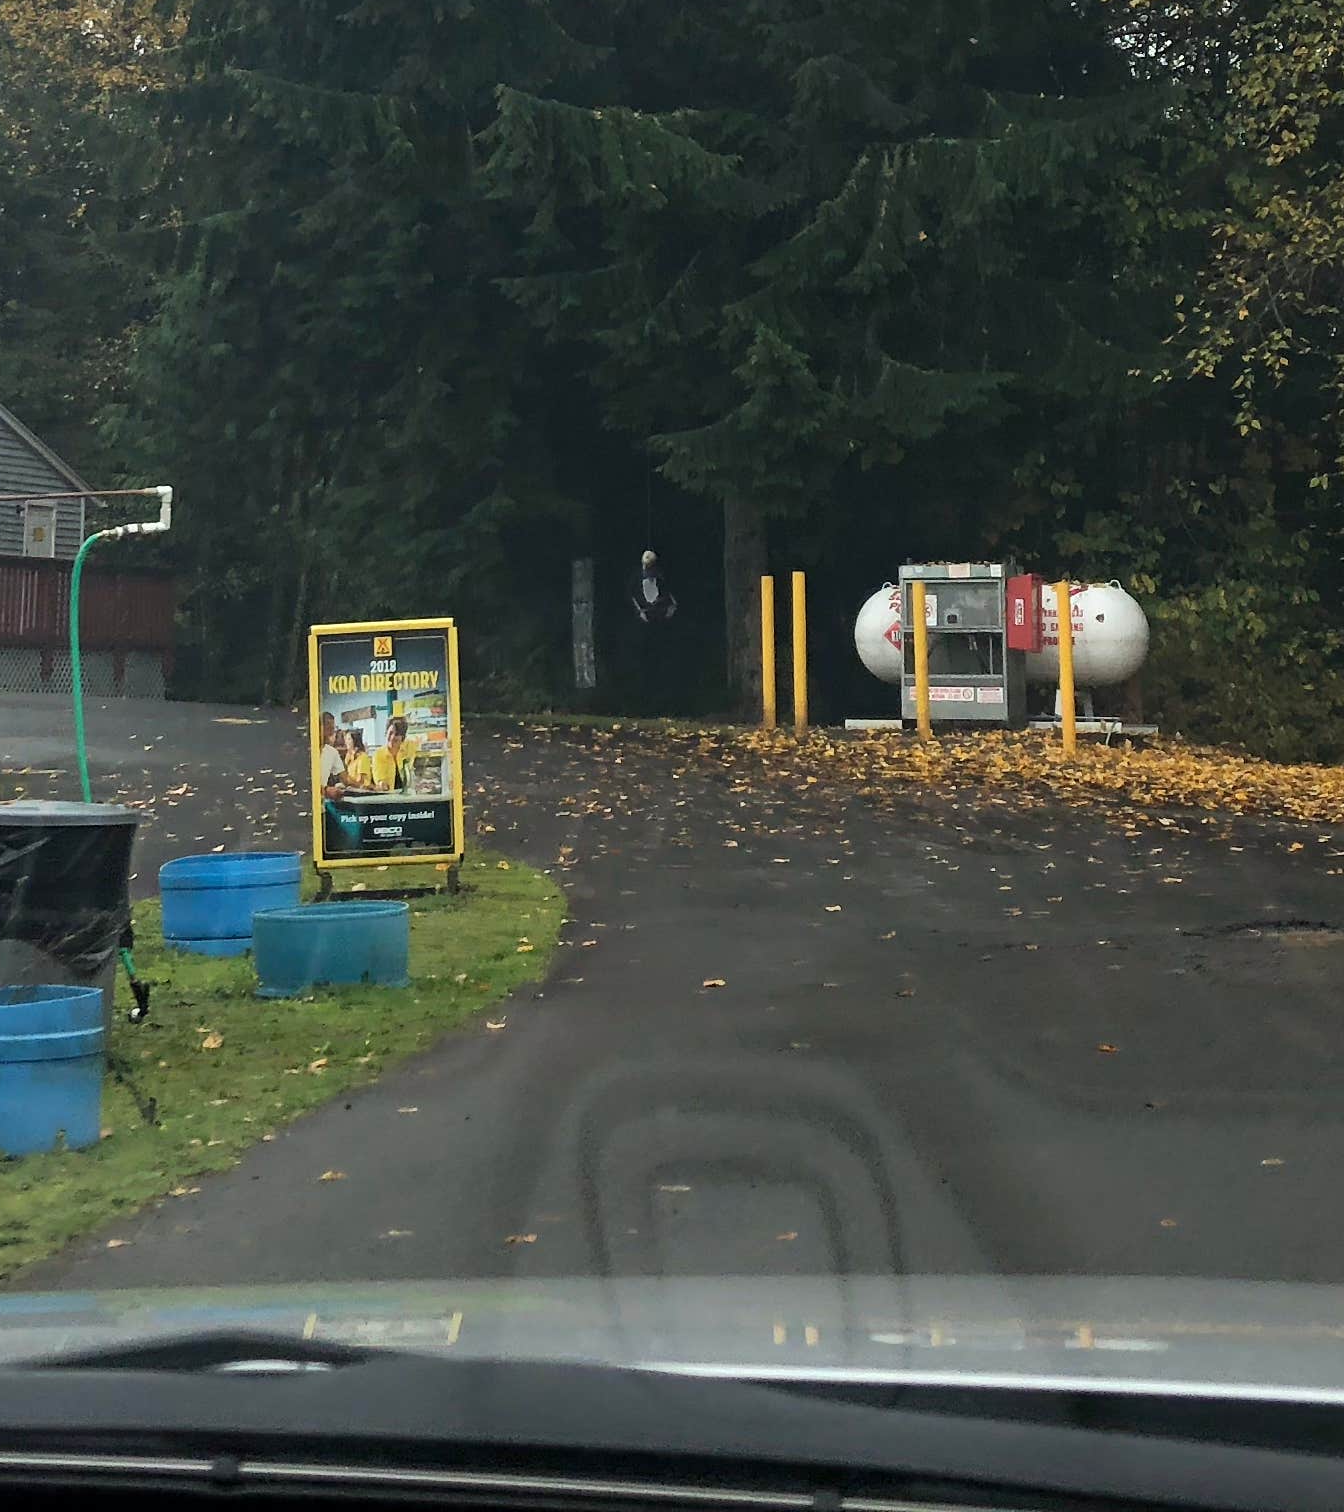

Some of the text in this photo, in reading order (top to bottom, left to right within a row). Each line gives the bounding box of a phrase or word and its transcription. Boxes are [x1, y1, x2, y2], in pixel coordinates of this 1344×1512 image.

[369, 659, 397, 673] 2018
[328, 670, 439, 694] KOA DIRECTORY
[340, 810, 435, 824] Pick up your copy inside!
